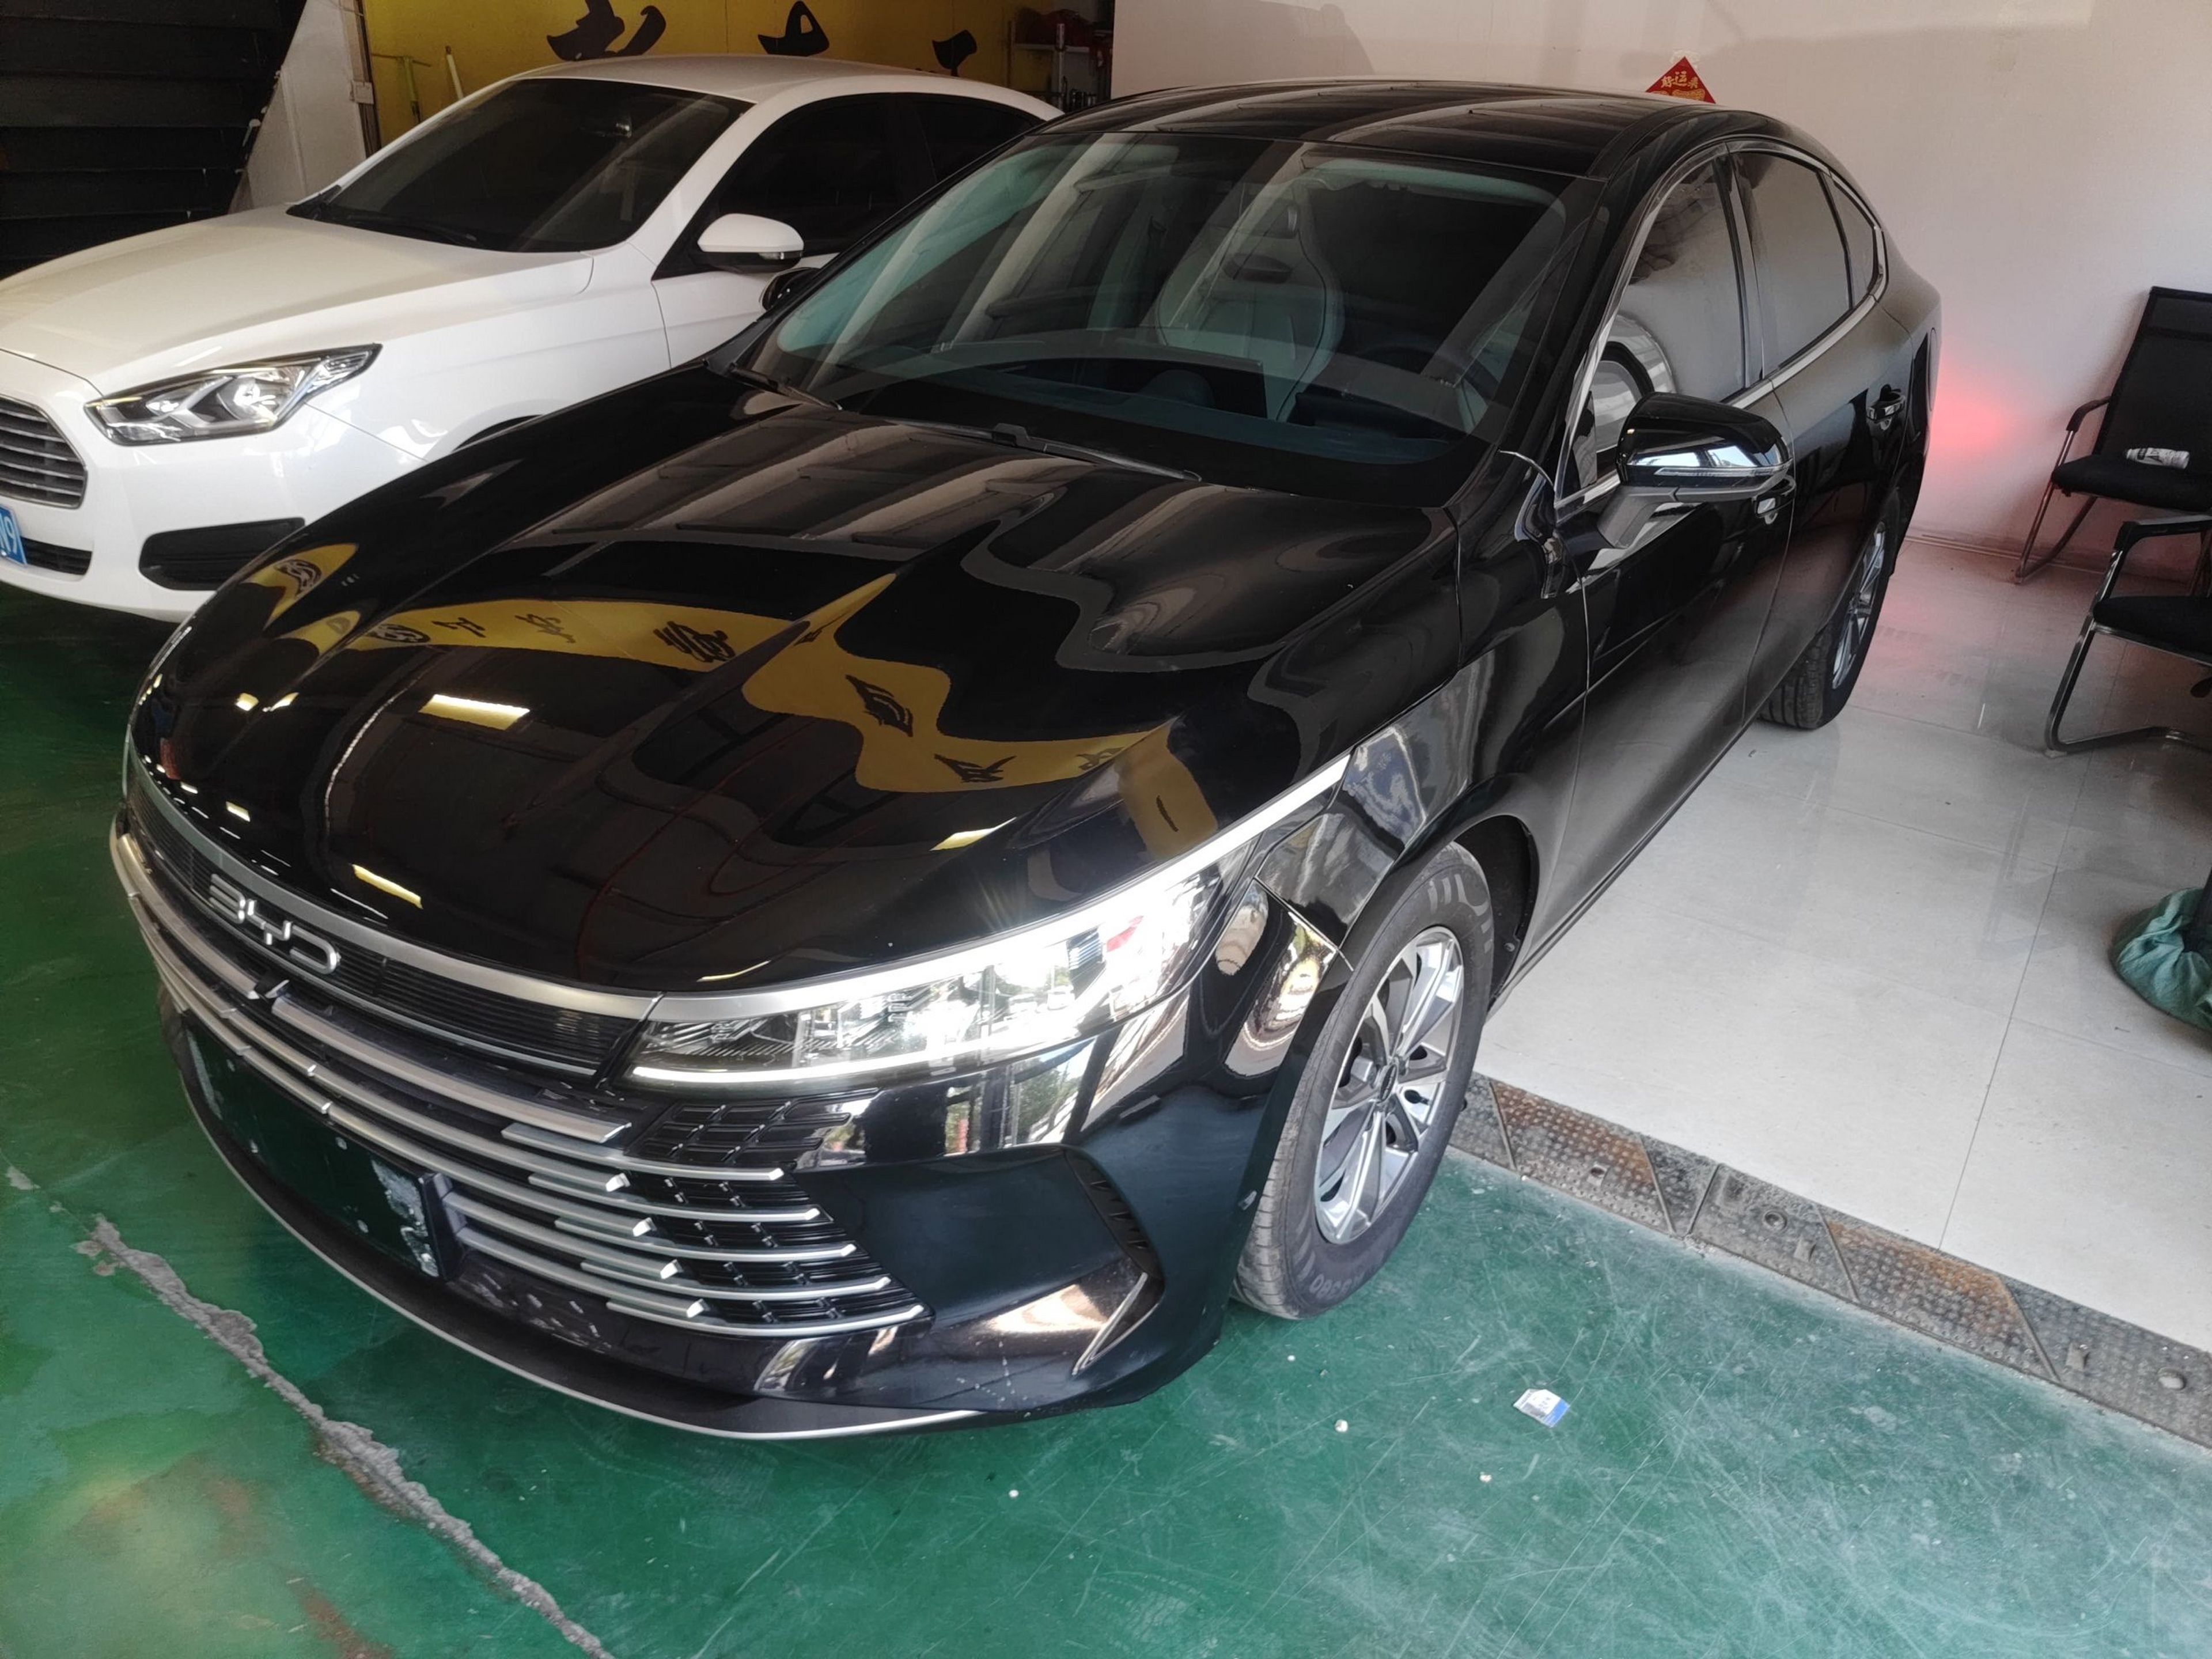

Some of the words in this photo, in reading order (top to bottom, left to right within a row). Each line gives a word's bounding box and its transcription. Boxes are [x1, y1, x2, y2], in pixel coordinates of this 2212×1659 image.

[1661, 71, 1699, 89] 好运来
[210, 873, 339, 974] BYD
